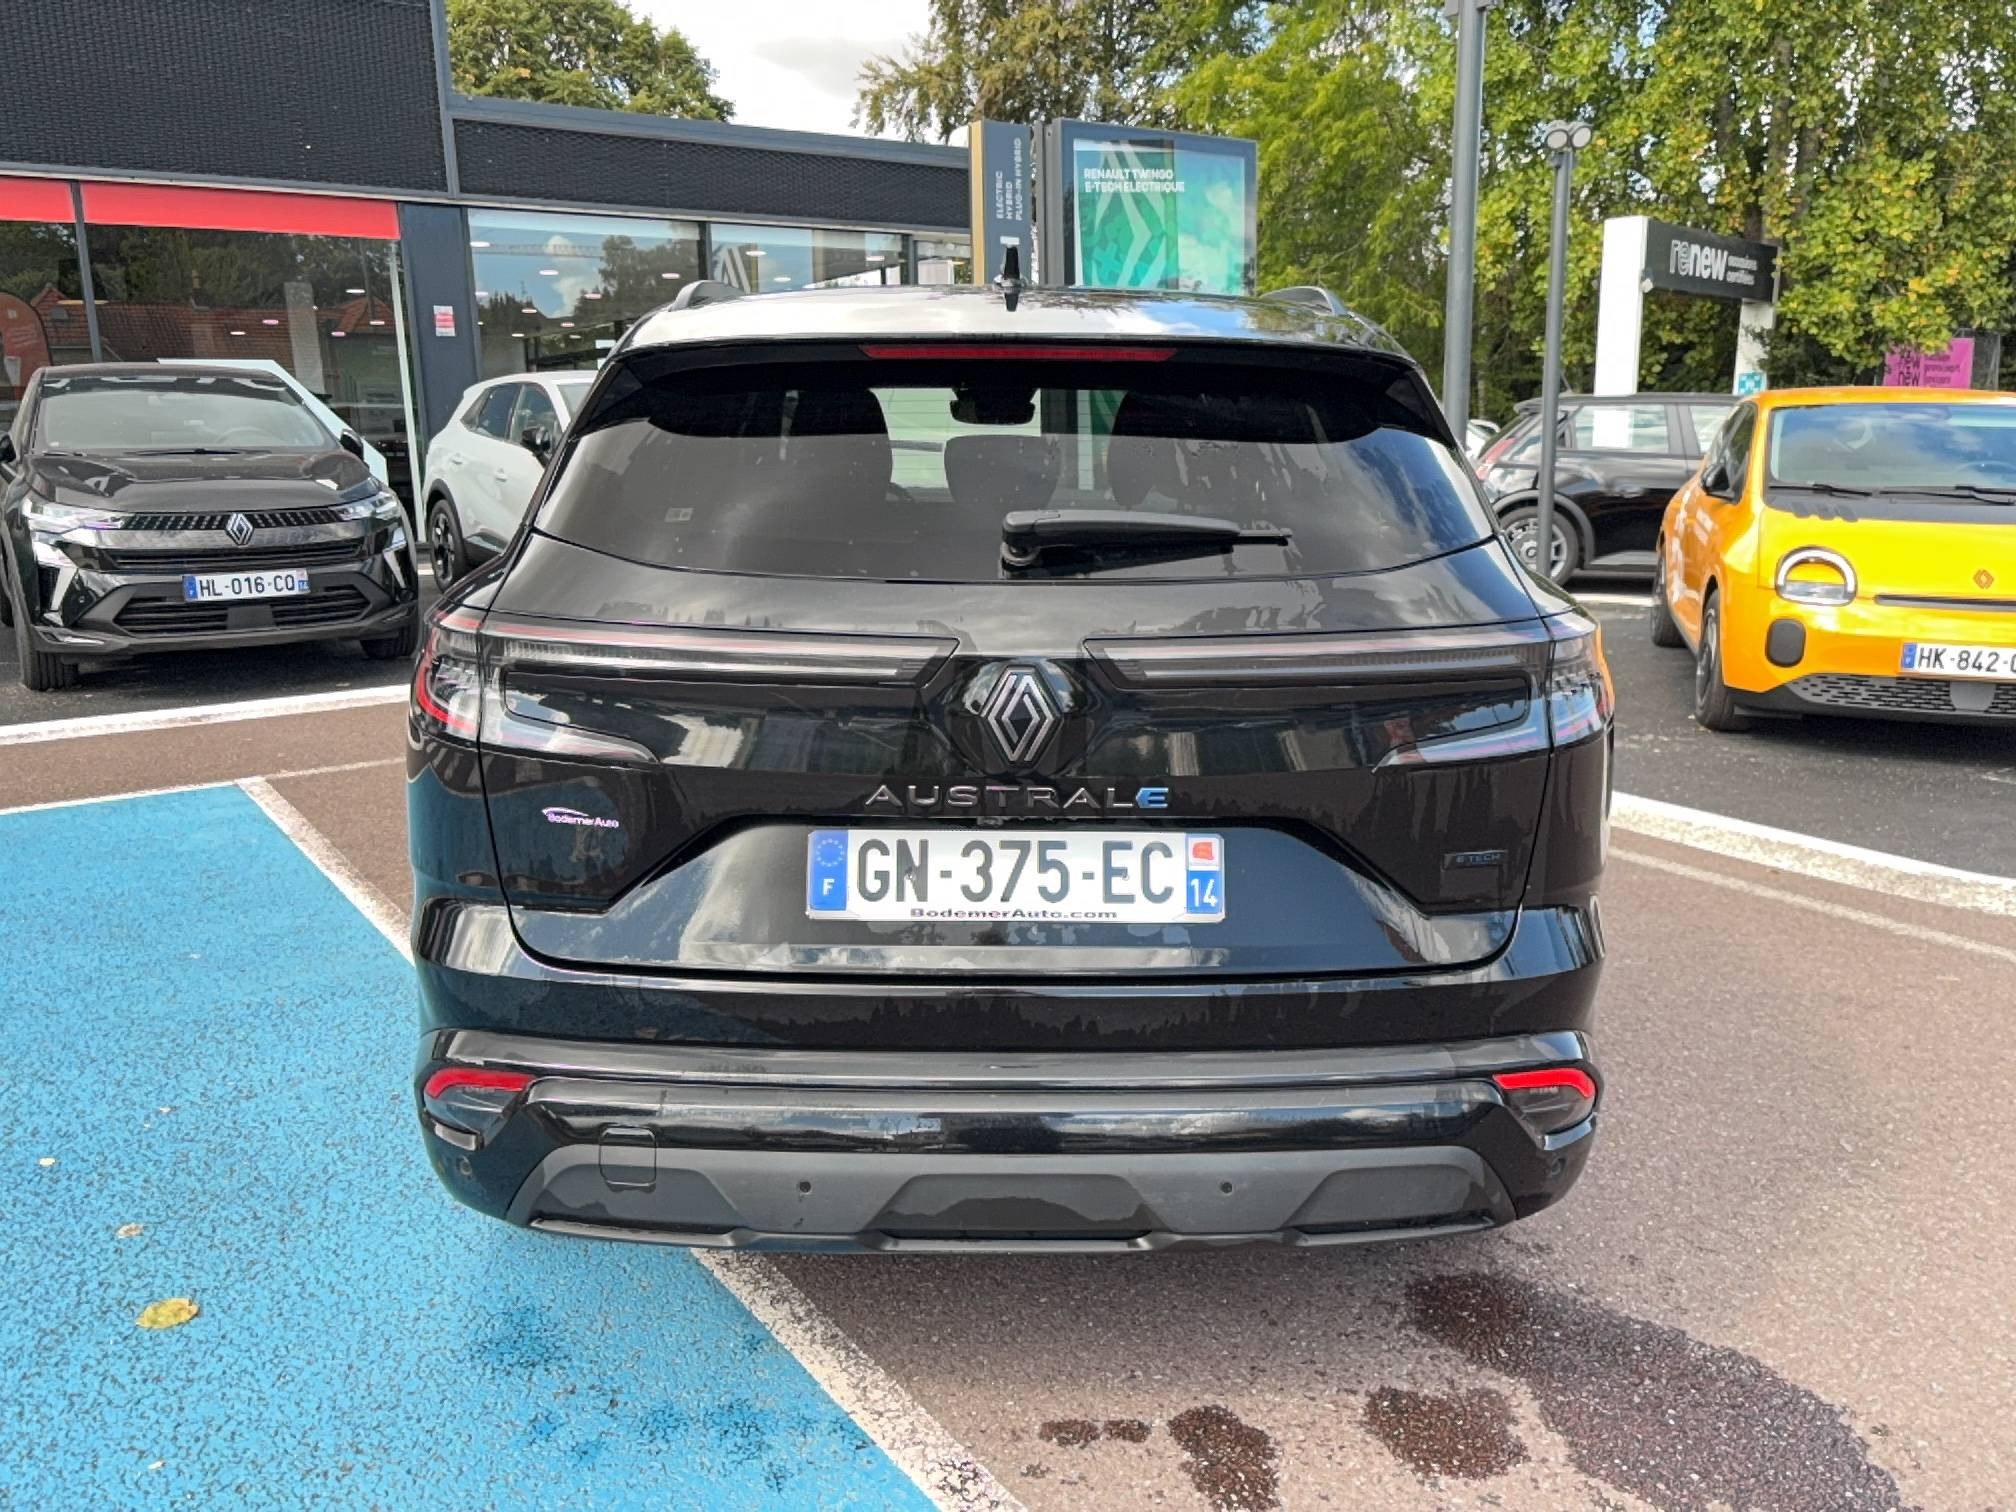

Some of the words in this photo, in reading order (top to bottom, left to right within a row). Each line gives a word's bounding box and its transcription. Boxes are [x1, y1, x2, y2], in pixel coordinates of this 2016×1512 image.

[1084, 168, 1130, 180] RENAULT
[1131, 169, 1174, 180] TWINGO
[1669, 239, 1729, 281] renew
[822, 878, 836, 896] F
[857, 838, 1174, 905] GN-375-EC
[1190, 878, 1219, 908] 14
[910, 908, 1118, 919] BodemerAuto.com
